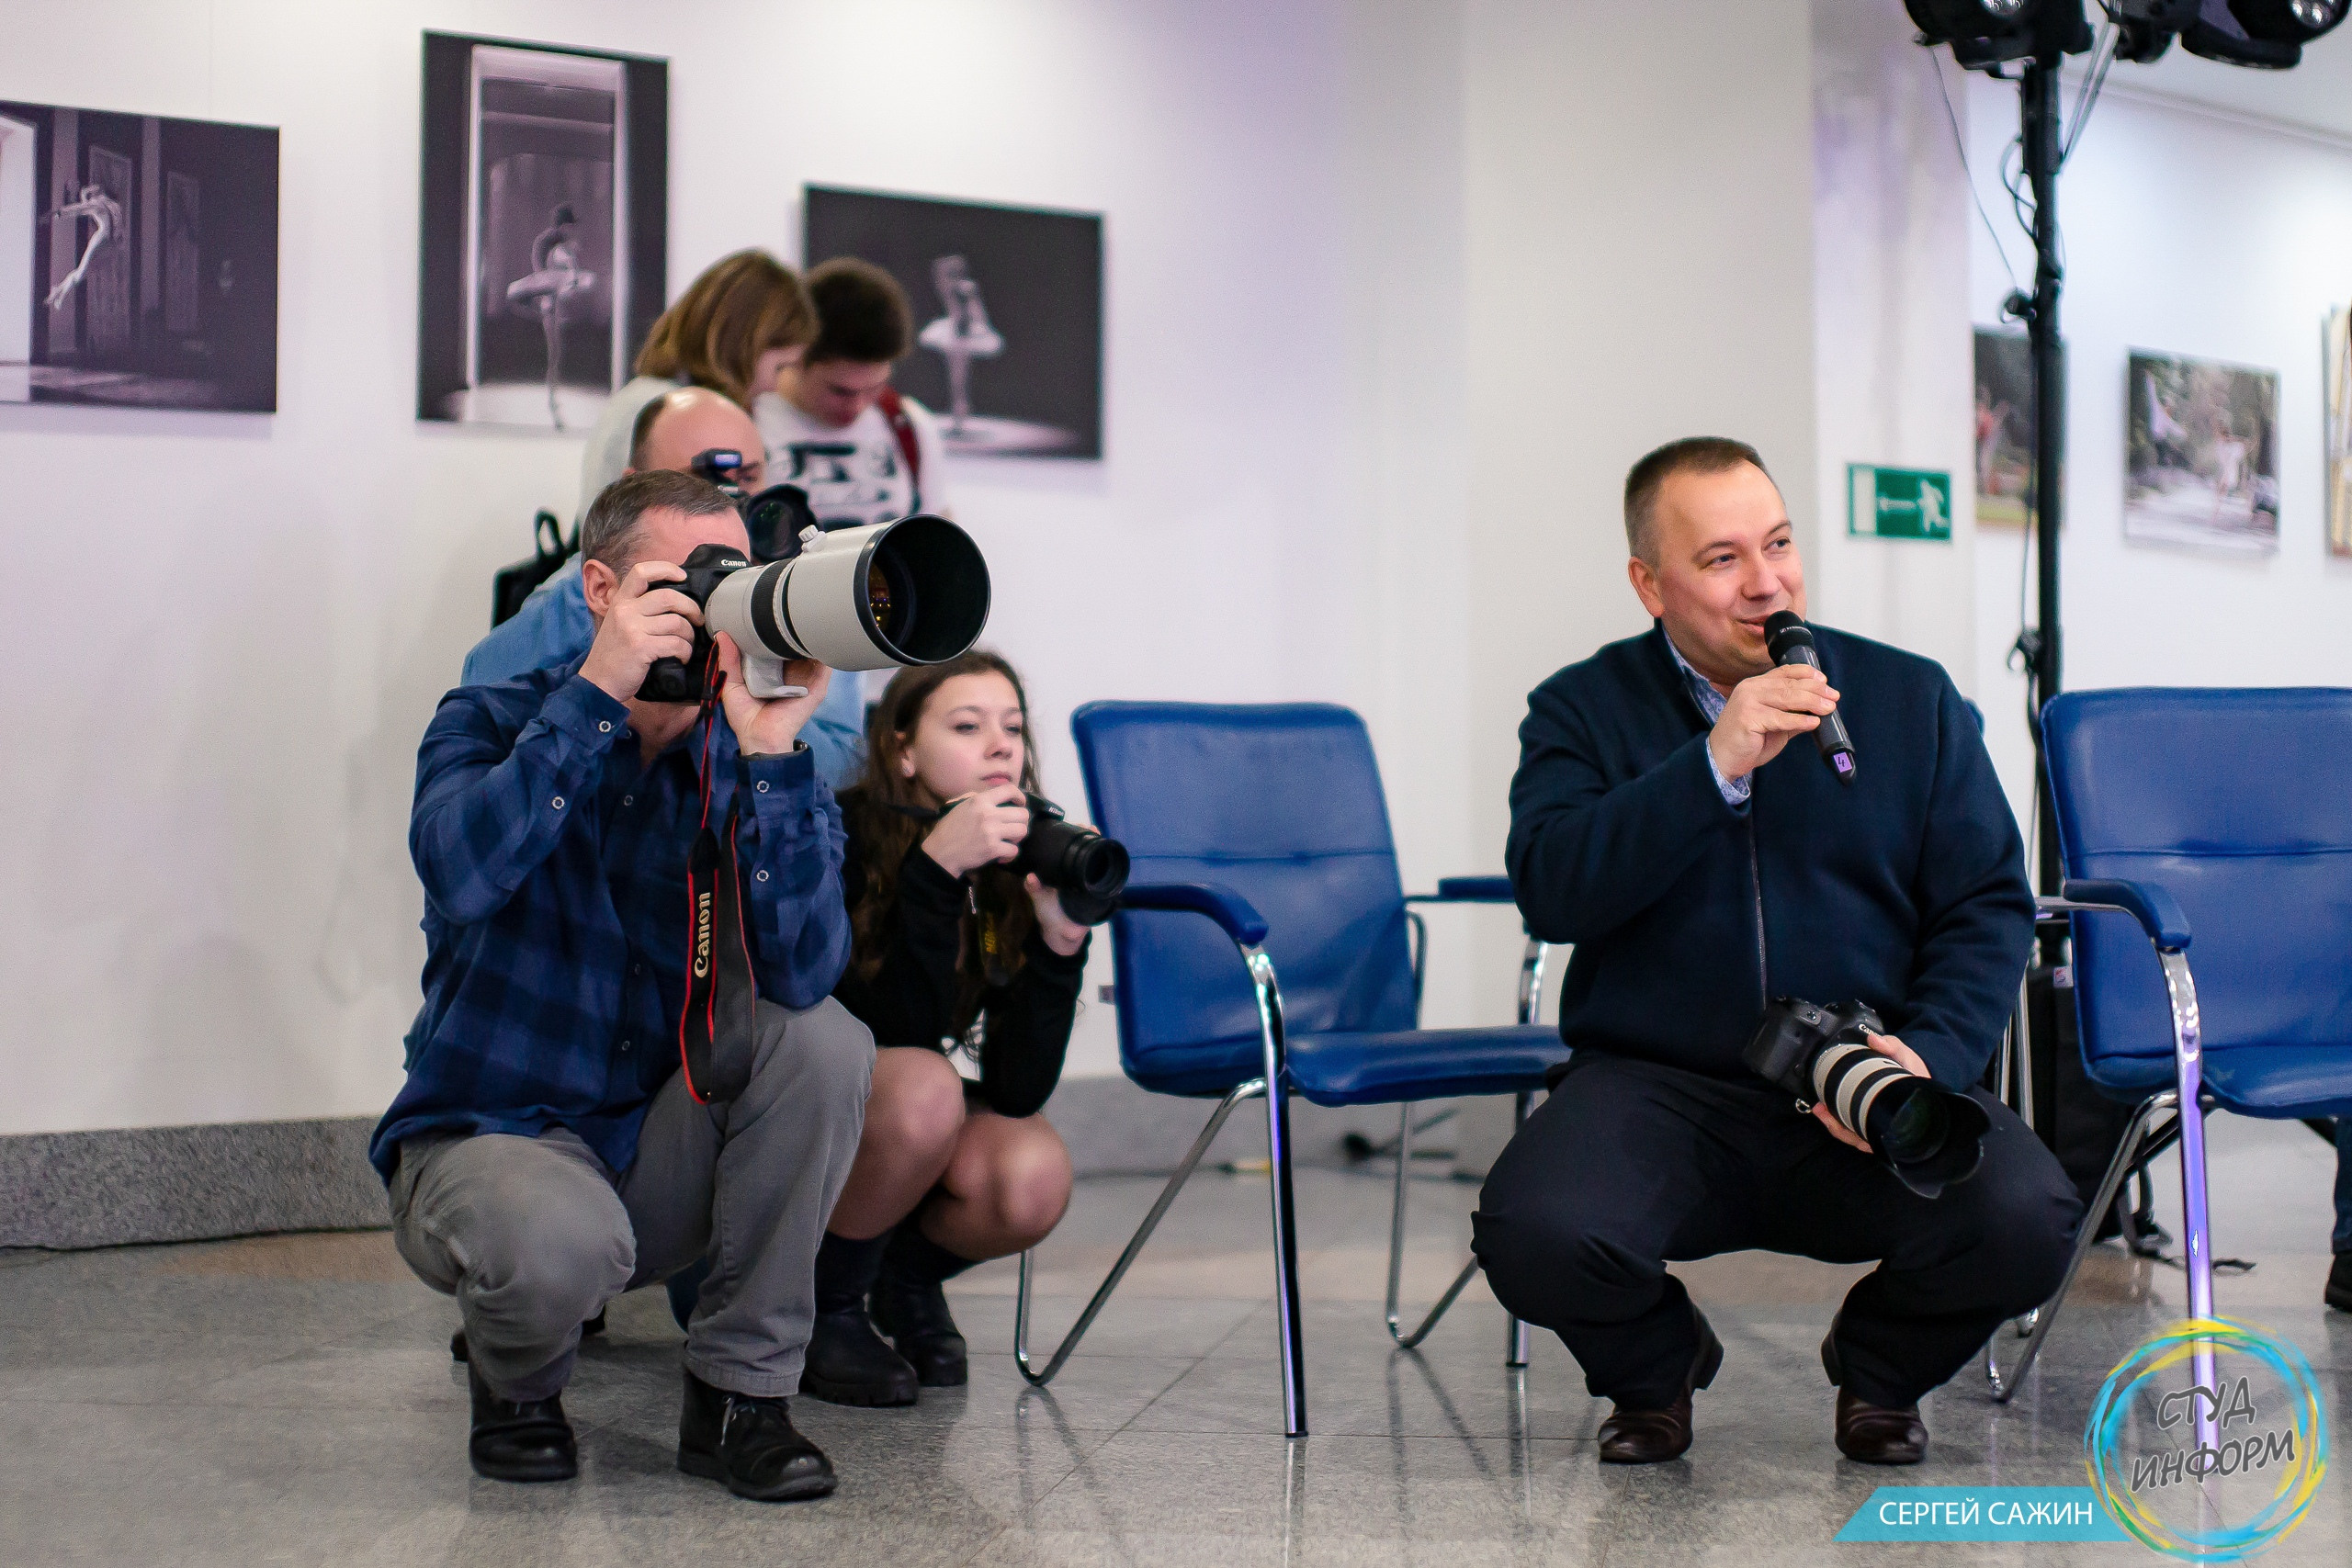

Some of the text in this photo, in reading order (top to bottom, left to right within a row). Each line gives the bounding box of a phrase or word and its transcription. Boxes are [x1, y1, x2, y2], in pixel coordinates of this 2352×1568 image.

[720, 558, 747, 567] Canon
[1838, 756, 1846, 767] 4
[694, 892, 711, 978] Canon
